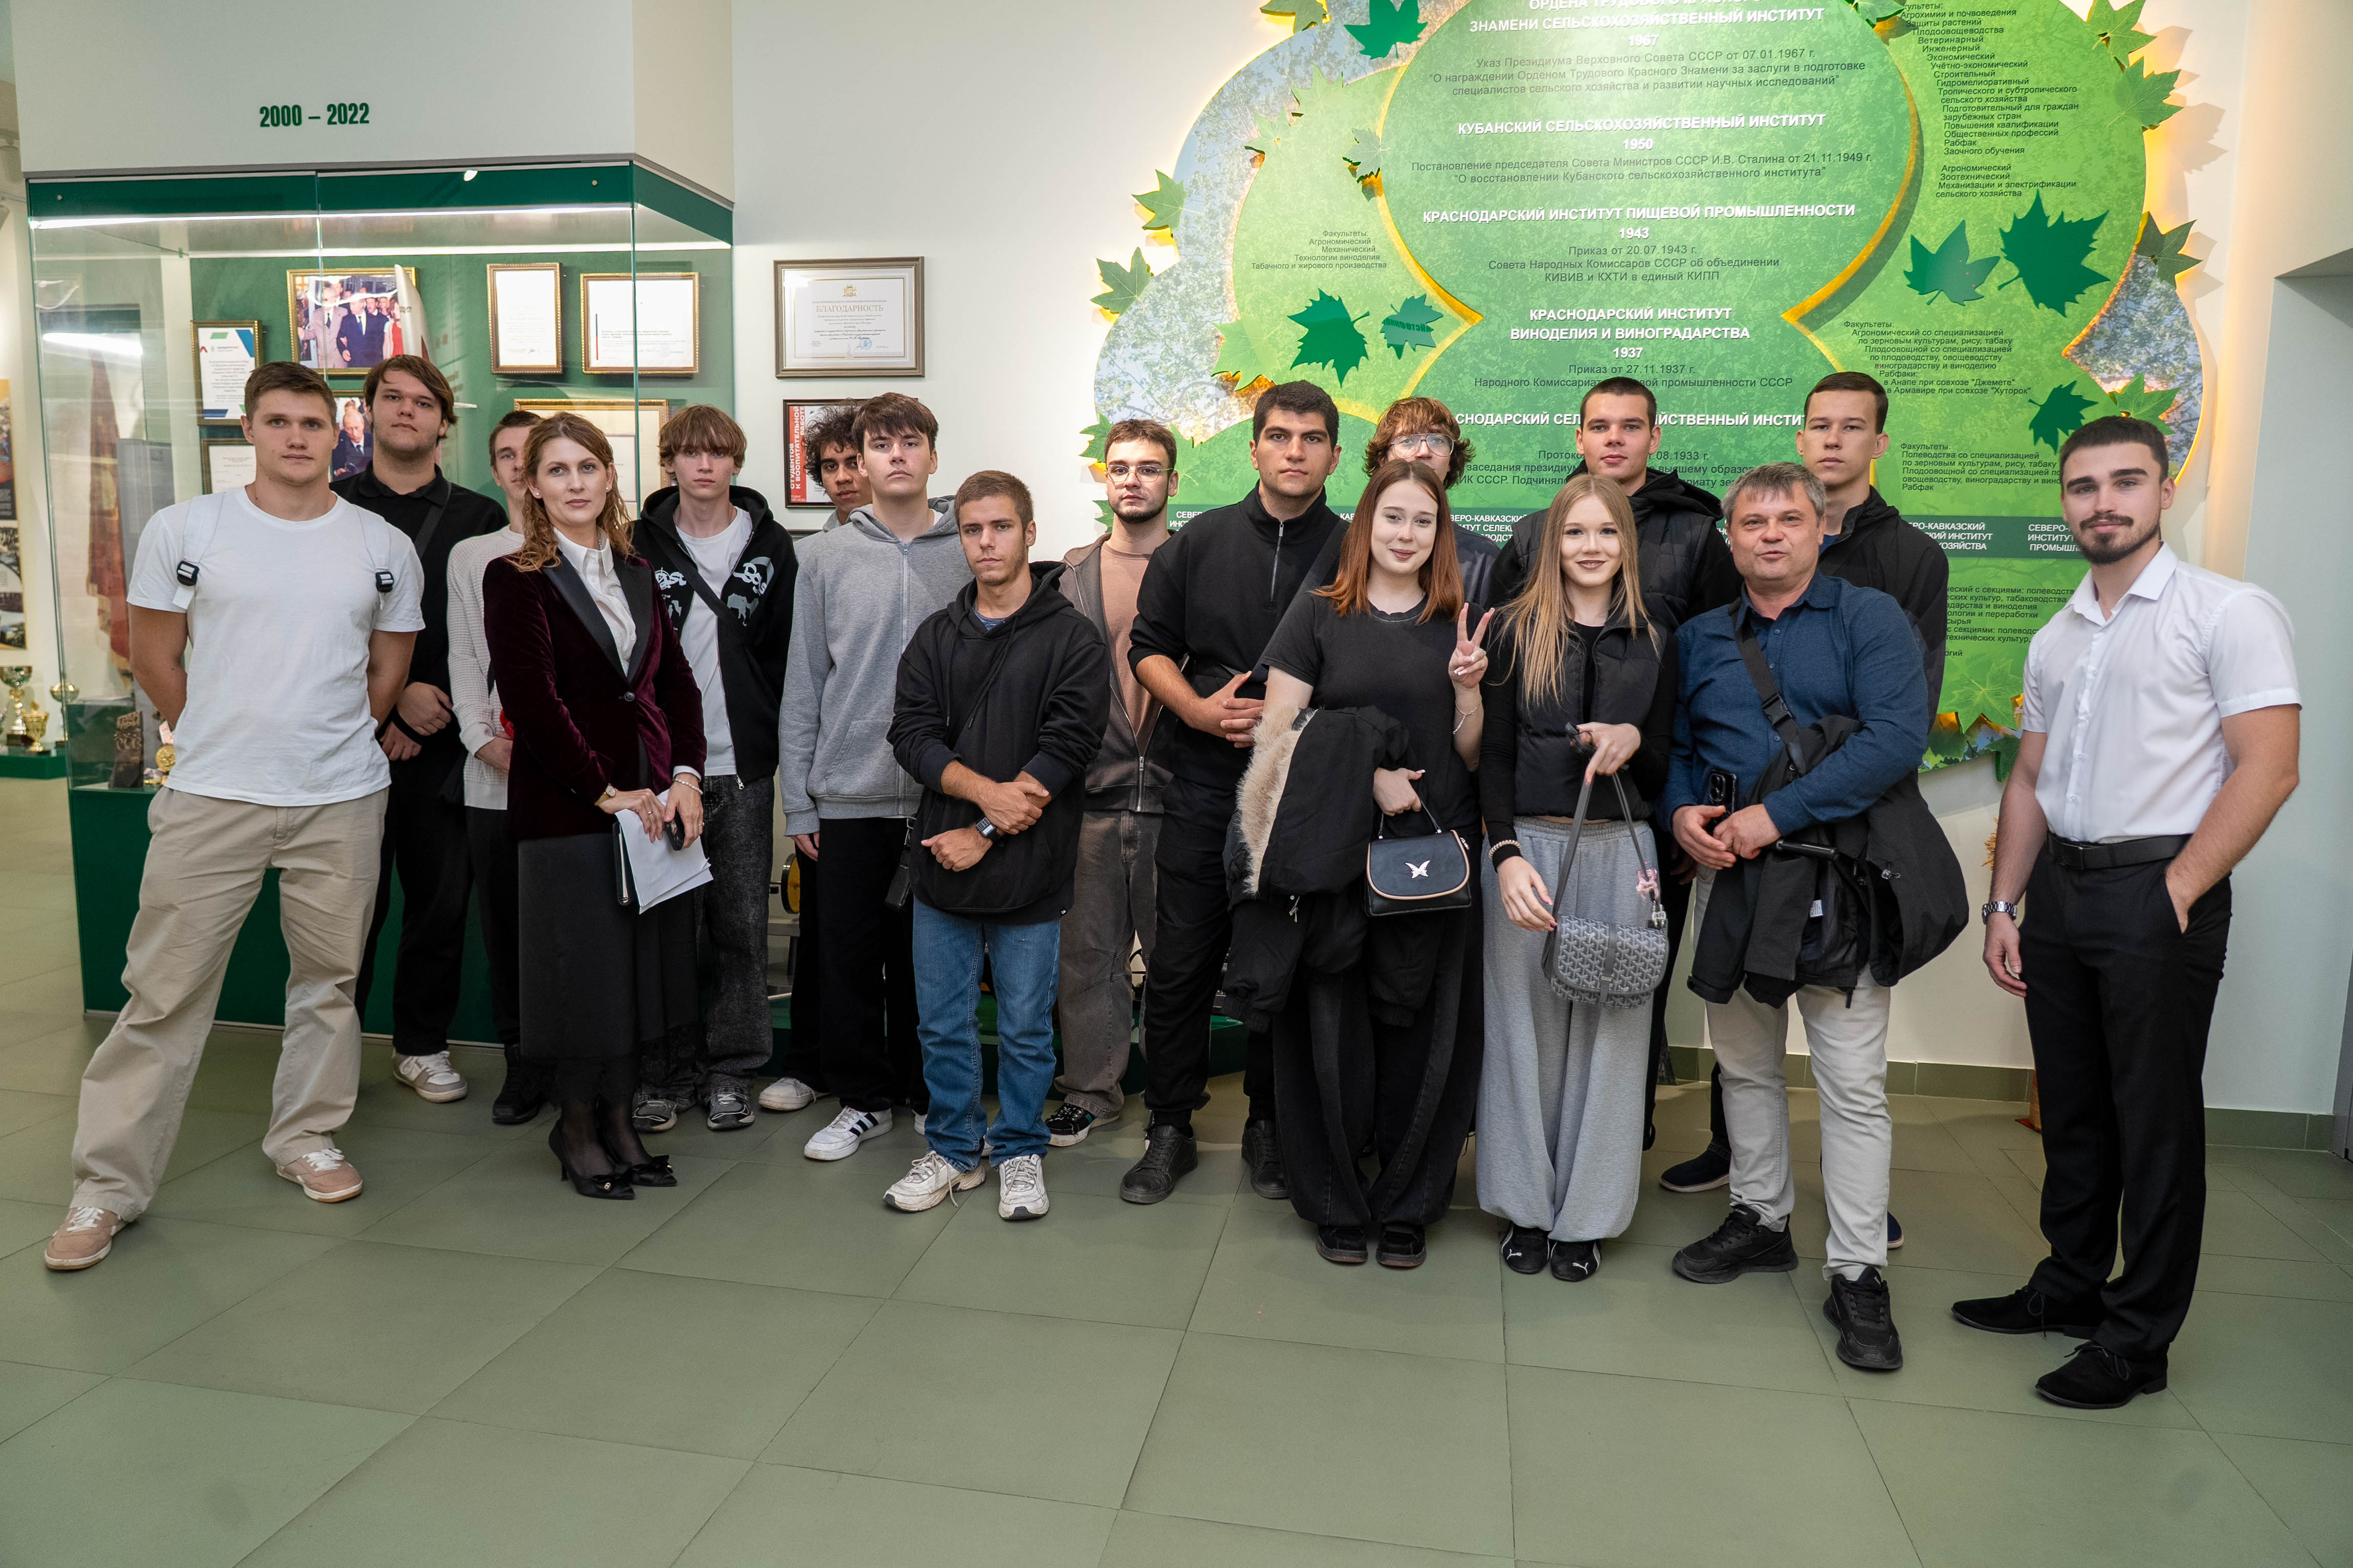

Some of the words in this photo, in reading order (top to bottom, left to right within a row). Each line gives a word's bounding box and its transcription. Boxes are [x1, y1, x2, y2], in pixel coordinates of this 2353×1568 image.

[1900, 11, 1945, 19] Агрохимии
[1470, 18, 1538, 32] ЗНАМЕНИ
[1542, 10, 1742, 30] СЕЛЬСКОХОЗЯЙСТВЕННЫЙ
[1747, 8, 1825, 22] ИНСТИТУТ
[1942, 18, 1981, 27] растений
[1628, 34, 1658, 47] 1967
[1918, 35, 1983, 44] Ветеринарный
[1922, 44, 1980, 52] Инженерный
[1476, 58, 1500, 68] Указ
[1504, 57, 1572, 68] Президиума
[1576, 55, 1640, 66] Верховного
[1644, 53, 1684, 62] Совета
[1688, 51, 1723, 61] СССР
[1726, 52, 1739, 60] от
[1742, 48, 1805, 59] 07.01.1967
[1926, 52, 1995, 60] Экономический
[1930, 60, 2028, 69] Учётно-экономический
[1445, 73, 1514, 83] награждении
[1517, 71, 1565, 81] Орденом
[1570, 69, 1623, 80] Трудового
[1628, 67, 1677, 78] Красного
[1681, 66, 1728, 74] Знамени
[1747, 65, 1790, 74] заслуги
[1804, 62, 1866, 72] подготовке
[1934, 70, 1996, 78] Строительный
[1936, 77, 2029, 87] Гидромелиоративный
[1452, 86, 1526, 95] специалистов
[1529, 84, 1581, 93] сельского
[1585, 82, 1639, 91] хозяйства
[1652, 81, 1702, 91] развитии
[1706, 80, 1752, 90] научных
[1937, 85, 1995, 96] Тропического
[2005, 86, 2077, 95] субтропического
[1941, 95, 1983, 103] сельского
[1984, 94, 2027, 102] хозяйства
[1942, 103, 2022, 112] Подготовительный
[259, 104, 302, 127] 2000
[327, 102, 370, 125] 2022
[1943, 113, 1995, 121] зарубежных
[1458, 119, 1541, 134] КУБАНСКИЙ
[1545, 115, 1745, 131] СЕЛЬСКОХОЗЯЙСТВЕННЫЙ
[1749, 114, 1826, 126] ИНСТИТУТ
[1944, 120, 1994, 129] Повышения
[2011, 128, 2059, 137] профессий
[1622, 138, 1654, 149] 1950
[1944, 139, 1977, 147] Рабфак
[1985, 147, 2025, 155] обучения
[1412, 162, 1492, 170] Постановление
[1495, 161, 1568, 170] председателя
[1572, 158, 1609, 167] Совета
[1613, 158, 1671, 167] Министров
[1676, 155, 1708, 165] СССР
[1712, 155, 1734, 164] И.В.
[1738, 155, 1785, 164] Сталина
[1803, 153, 1862, 162] 21.11.1949
[1941, 164, 2011, 172] Агрономический
[1470, 174, 1558, 182] восстановлении
[1563, 171, 1624, 182] Кубанского
[1628, 169, 1760, 179] сельскохозяйственного
[1940, 172, 2010, 180] Зоотехнический
[1423, 207, 1544, 222] КРАСНОДАРСКИЙ
[1549, 208, 1623, 220] ИНСТИТУТ
[1626, 205, 1700, 219] ПИЩЕВОЙ
[1704, 204, 1855, 217] ПРОМЫШЛЕННОСТИ
[1619, 227, 1649, 238] 1943
[1568, 246, 1607, 257] Приказ
[1626, 245, 1687, 254] 20.07.1943
[1489, 260, 1525, 269] Совета
[1530, 260, 1583, 270] Народных
[1586, 259, 1650, 269] Комиссаров
[1654, 258, 1686, 267] СССР
[1690, 257, 1703, 267] об
[1706, 257, 1779, 267] объединении
[1545, 272, 1583, 282] КИВИВ
[1598, 272, 1627, 281] КХТИ
[1641, 271, 1683, 282] единый
[1687, 271, 1719, 280] КИПП
[816, 305, 884, 313] БЛАГОДАРНОСТЬ
[1530, 307, 1654, 321] КРАСНОДАРСКИЙ
[1658, 308, 1732, 318] ИНСТИТУТ
[1510, 328, 1597, 340] ВИНОДЕЛИЯ
[1601, 328, 1610, 338] И
[1615, 327, 1750, 340] ВИНОГРАДАРСТВА
[1851, 328, 1920, 337] Агрономический
[1934, 329, 2003, 337] специализацией
[1613, 347, 1643, 357] 1937
[1569, 364, 1607, 375] Приказ
[1626, 364, 1685, 373] 27.11.1937
[1474, 378, 1530, 388] Народного
[1661, 380, 1756, 388] промышленности
[1760, 377, 1792, 386] СССР
[1902, 483, 1934, 491] Рабфак
[2028, 524, 2070, 532] СЕВЕРО-
[1948, 532, 1994, 541] ИНСТИТУТ
[1939, 541, 1987, 550] ОЗЯЙСТВА
[2029, 544, 2080, 552] ПРОМЫШЛ
